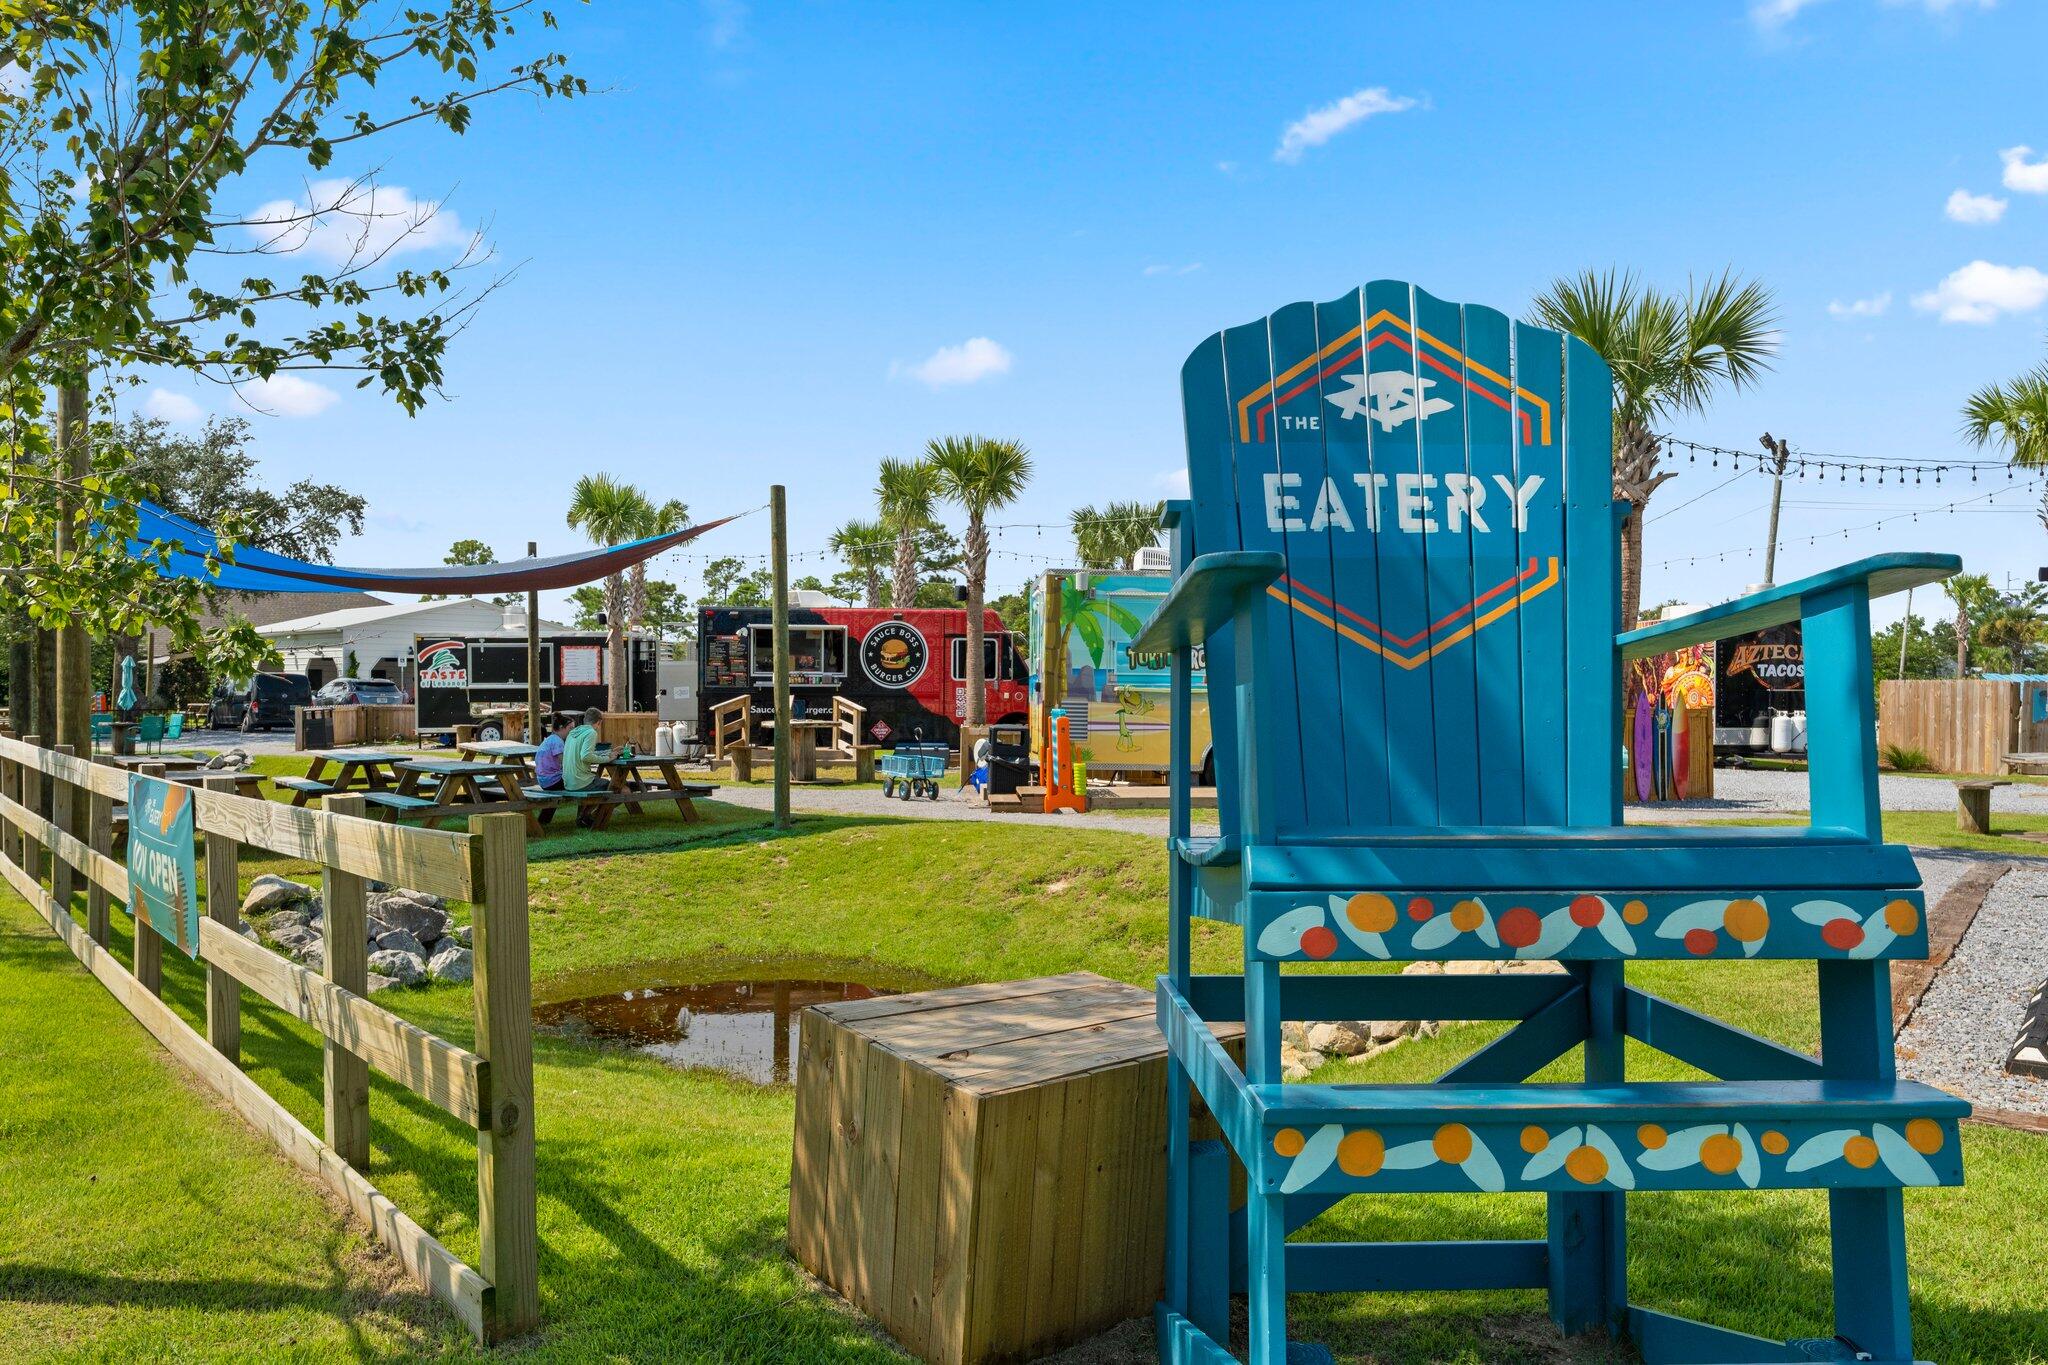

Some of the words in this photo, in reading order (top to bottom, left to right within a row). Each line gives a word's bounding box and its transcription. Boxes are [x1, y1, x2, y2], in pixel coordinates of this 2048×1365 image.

[1282, 416, 1320, 430] THE
[1263, 473, 1546, 533] EATERY
[870, 628, 896, 647] SAUCE
[899, 628, 919, 648] BOSS
[1127, 647, 1172, 670] TURT
[420, 670, 466, 680] TASTE
[870, 663, 903, 682] BURGER
[905, 664, 919, 677] CO.
[1757, 663, 1805, 677] TACOS
[149, 849, 179, 897] OPEN
